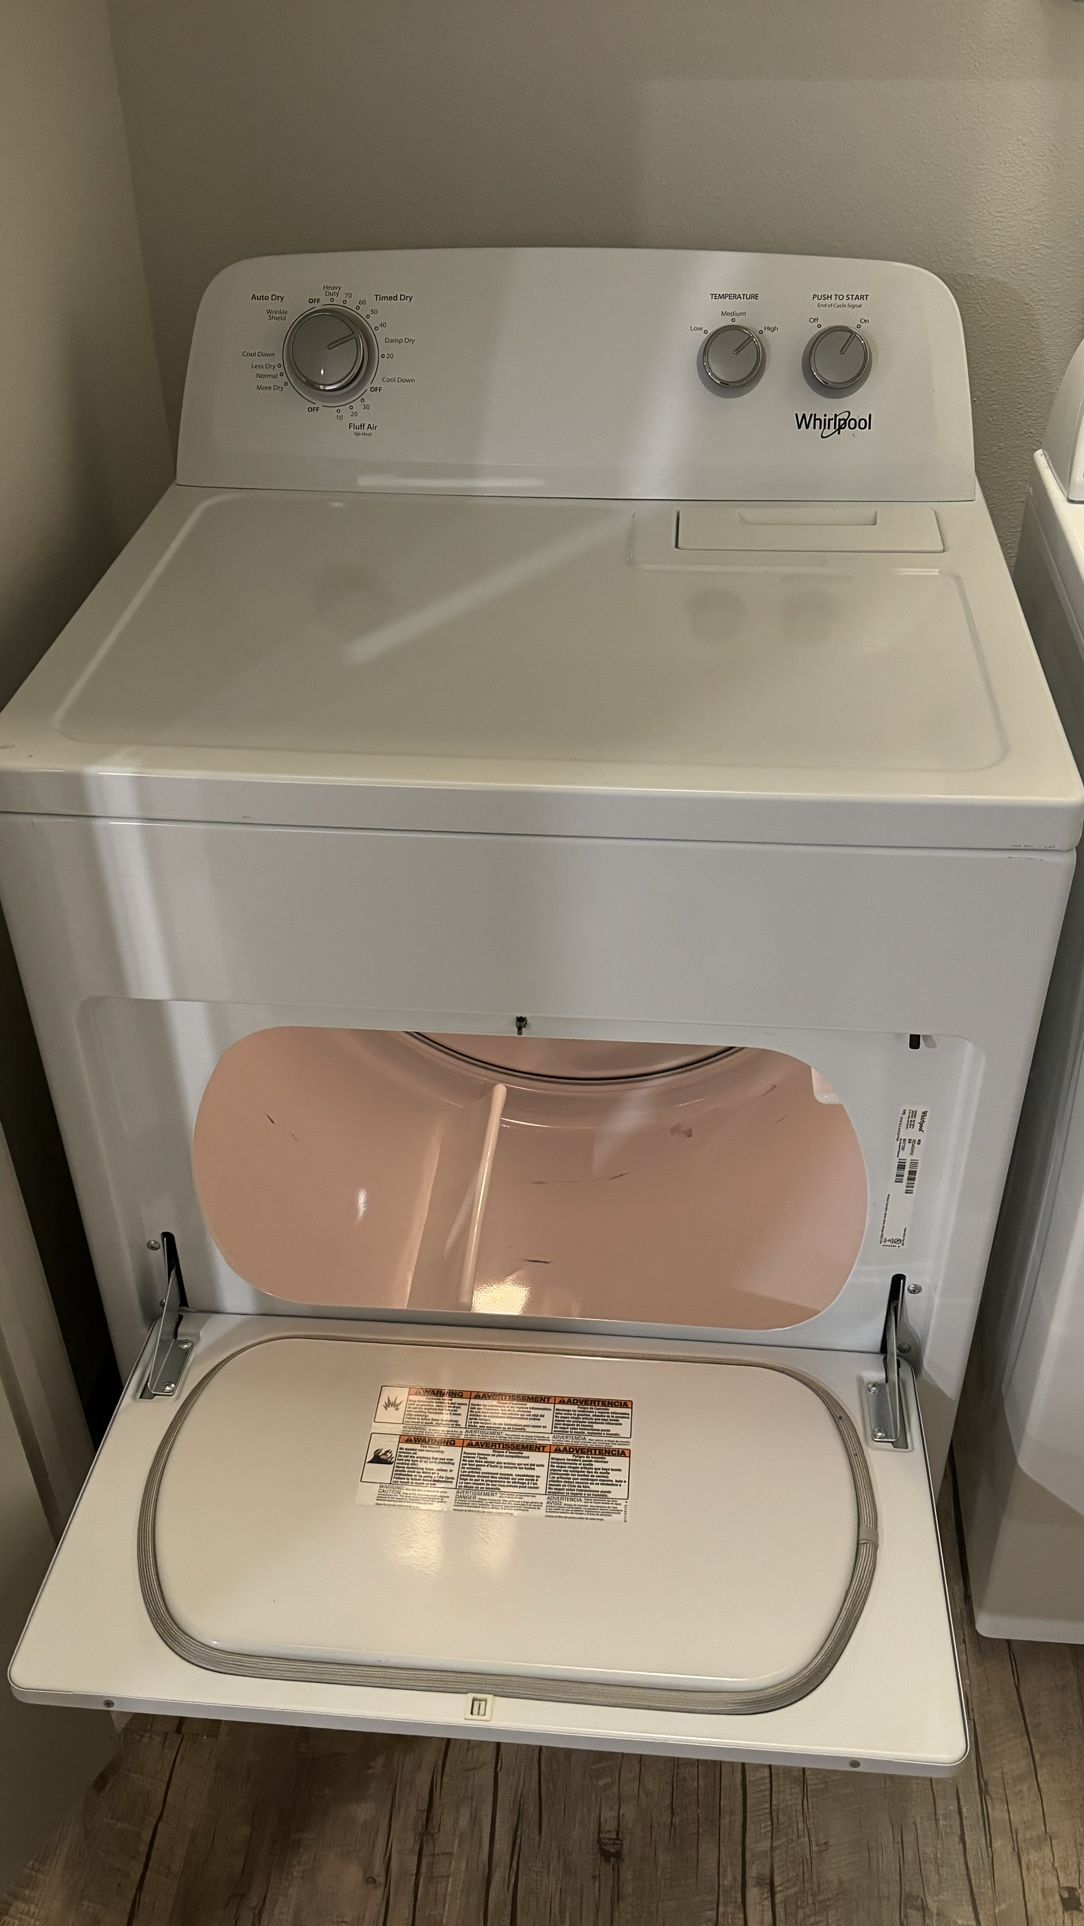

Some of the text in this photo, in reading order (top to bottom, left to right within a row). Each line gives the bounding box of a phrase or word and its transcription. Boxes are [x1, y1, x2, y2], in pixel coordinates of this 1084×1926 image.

[795, 411, 871, 438] Whirlpool
[421, 1389, 464, 1398] WARNING
[480, 1393, 552, 1403] AVERTISSEMENT
[564, 1397, 628, 1407] ADVERTENCIA
[412, 1436, 456, 1446] WARNING
[473, 1441, 546, 1452] AVERTISSEMENT
[560, 1446, 626, 1456] ADVERTENCIA
